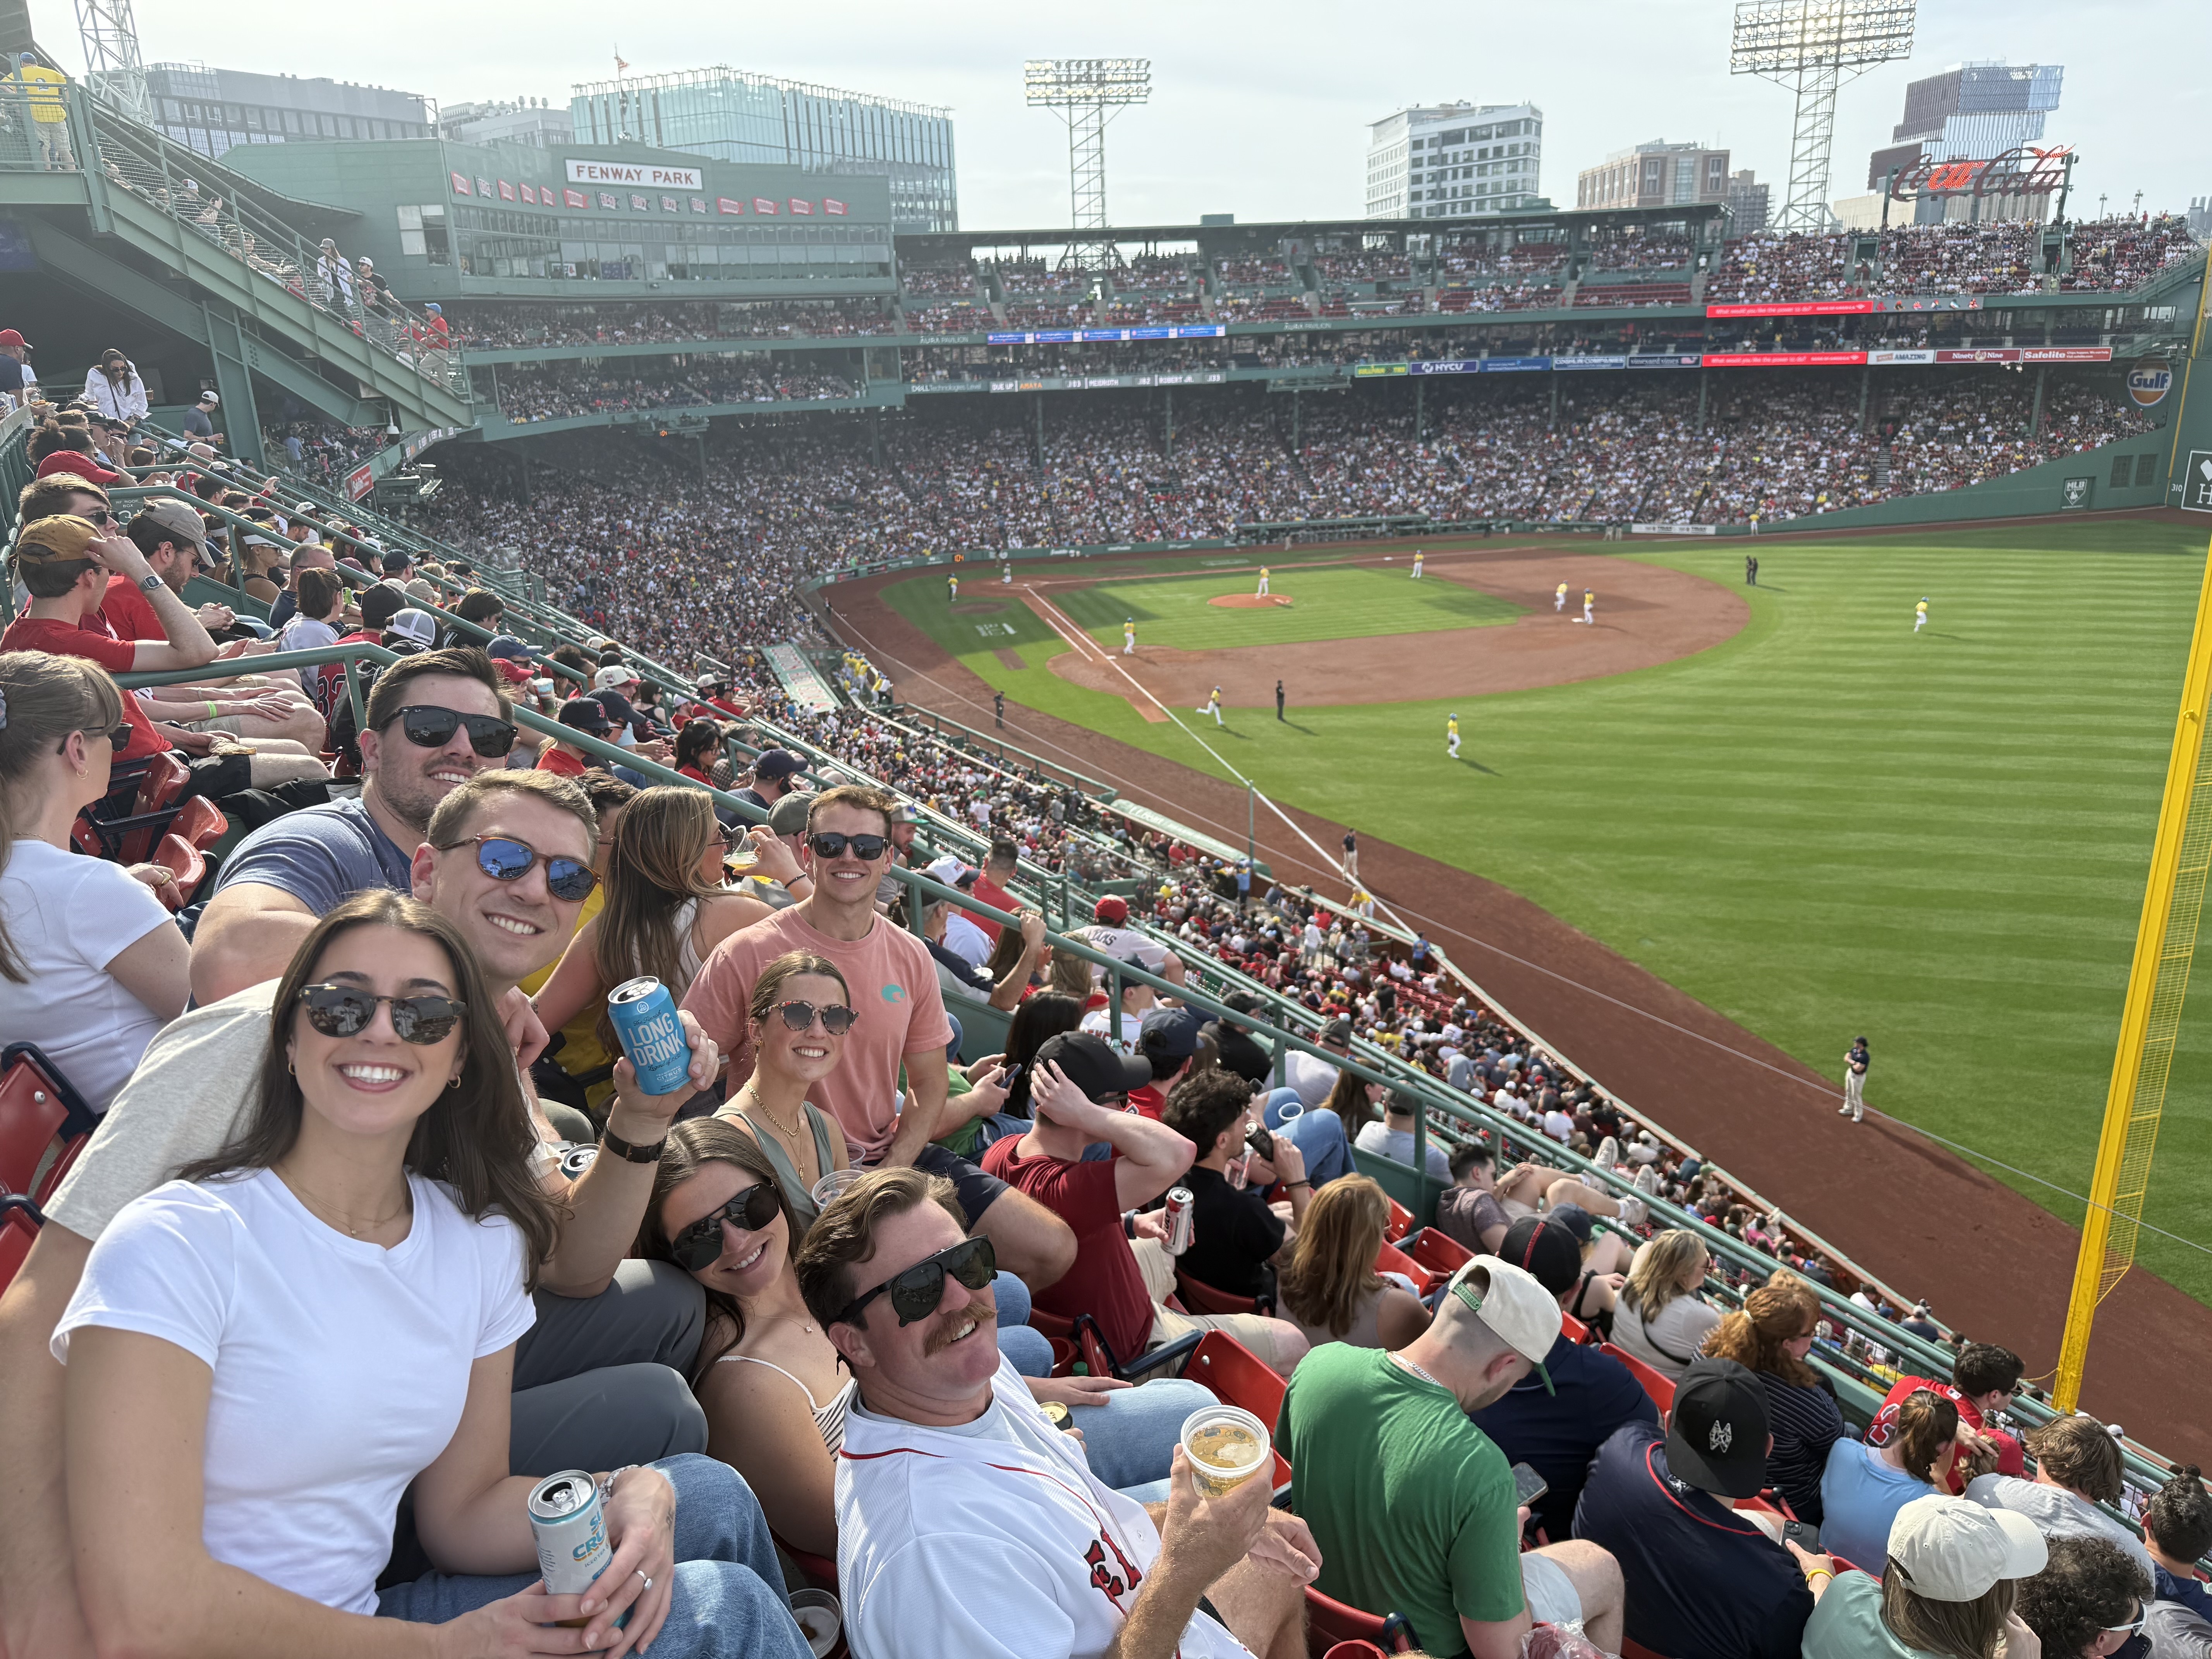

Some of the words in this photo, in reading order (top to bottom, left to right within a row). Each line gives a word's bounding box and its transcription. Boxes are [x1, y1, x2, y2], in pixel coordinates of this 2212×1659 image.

[576, 165, 642, 181] FENWAY
[653, 170, 694, 185] PARK
[1435, 363, 1464, 371] HYCU
[2129, 372, 2169, 389] Gulf
[2171, 484, 2183, 492] 310
[627, 1012, 674, 1047] LONG
[632, 1028, 684, 1066] DRINK
[657, 1068, 682, 1081] CITRUS
[584, 1557, 598, 1568] ICED
[597, 1549, 606, 1558] TEA
